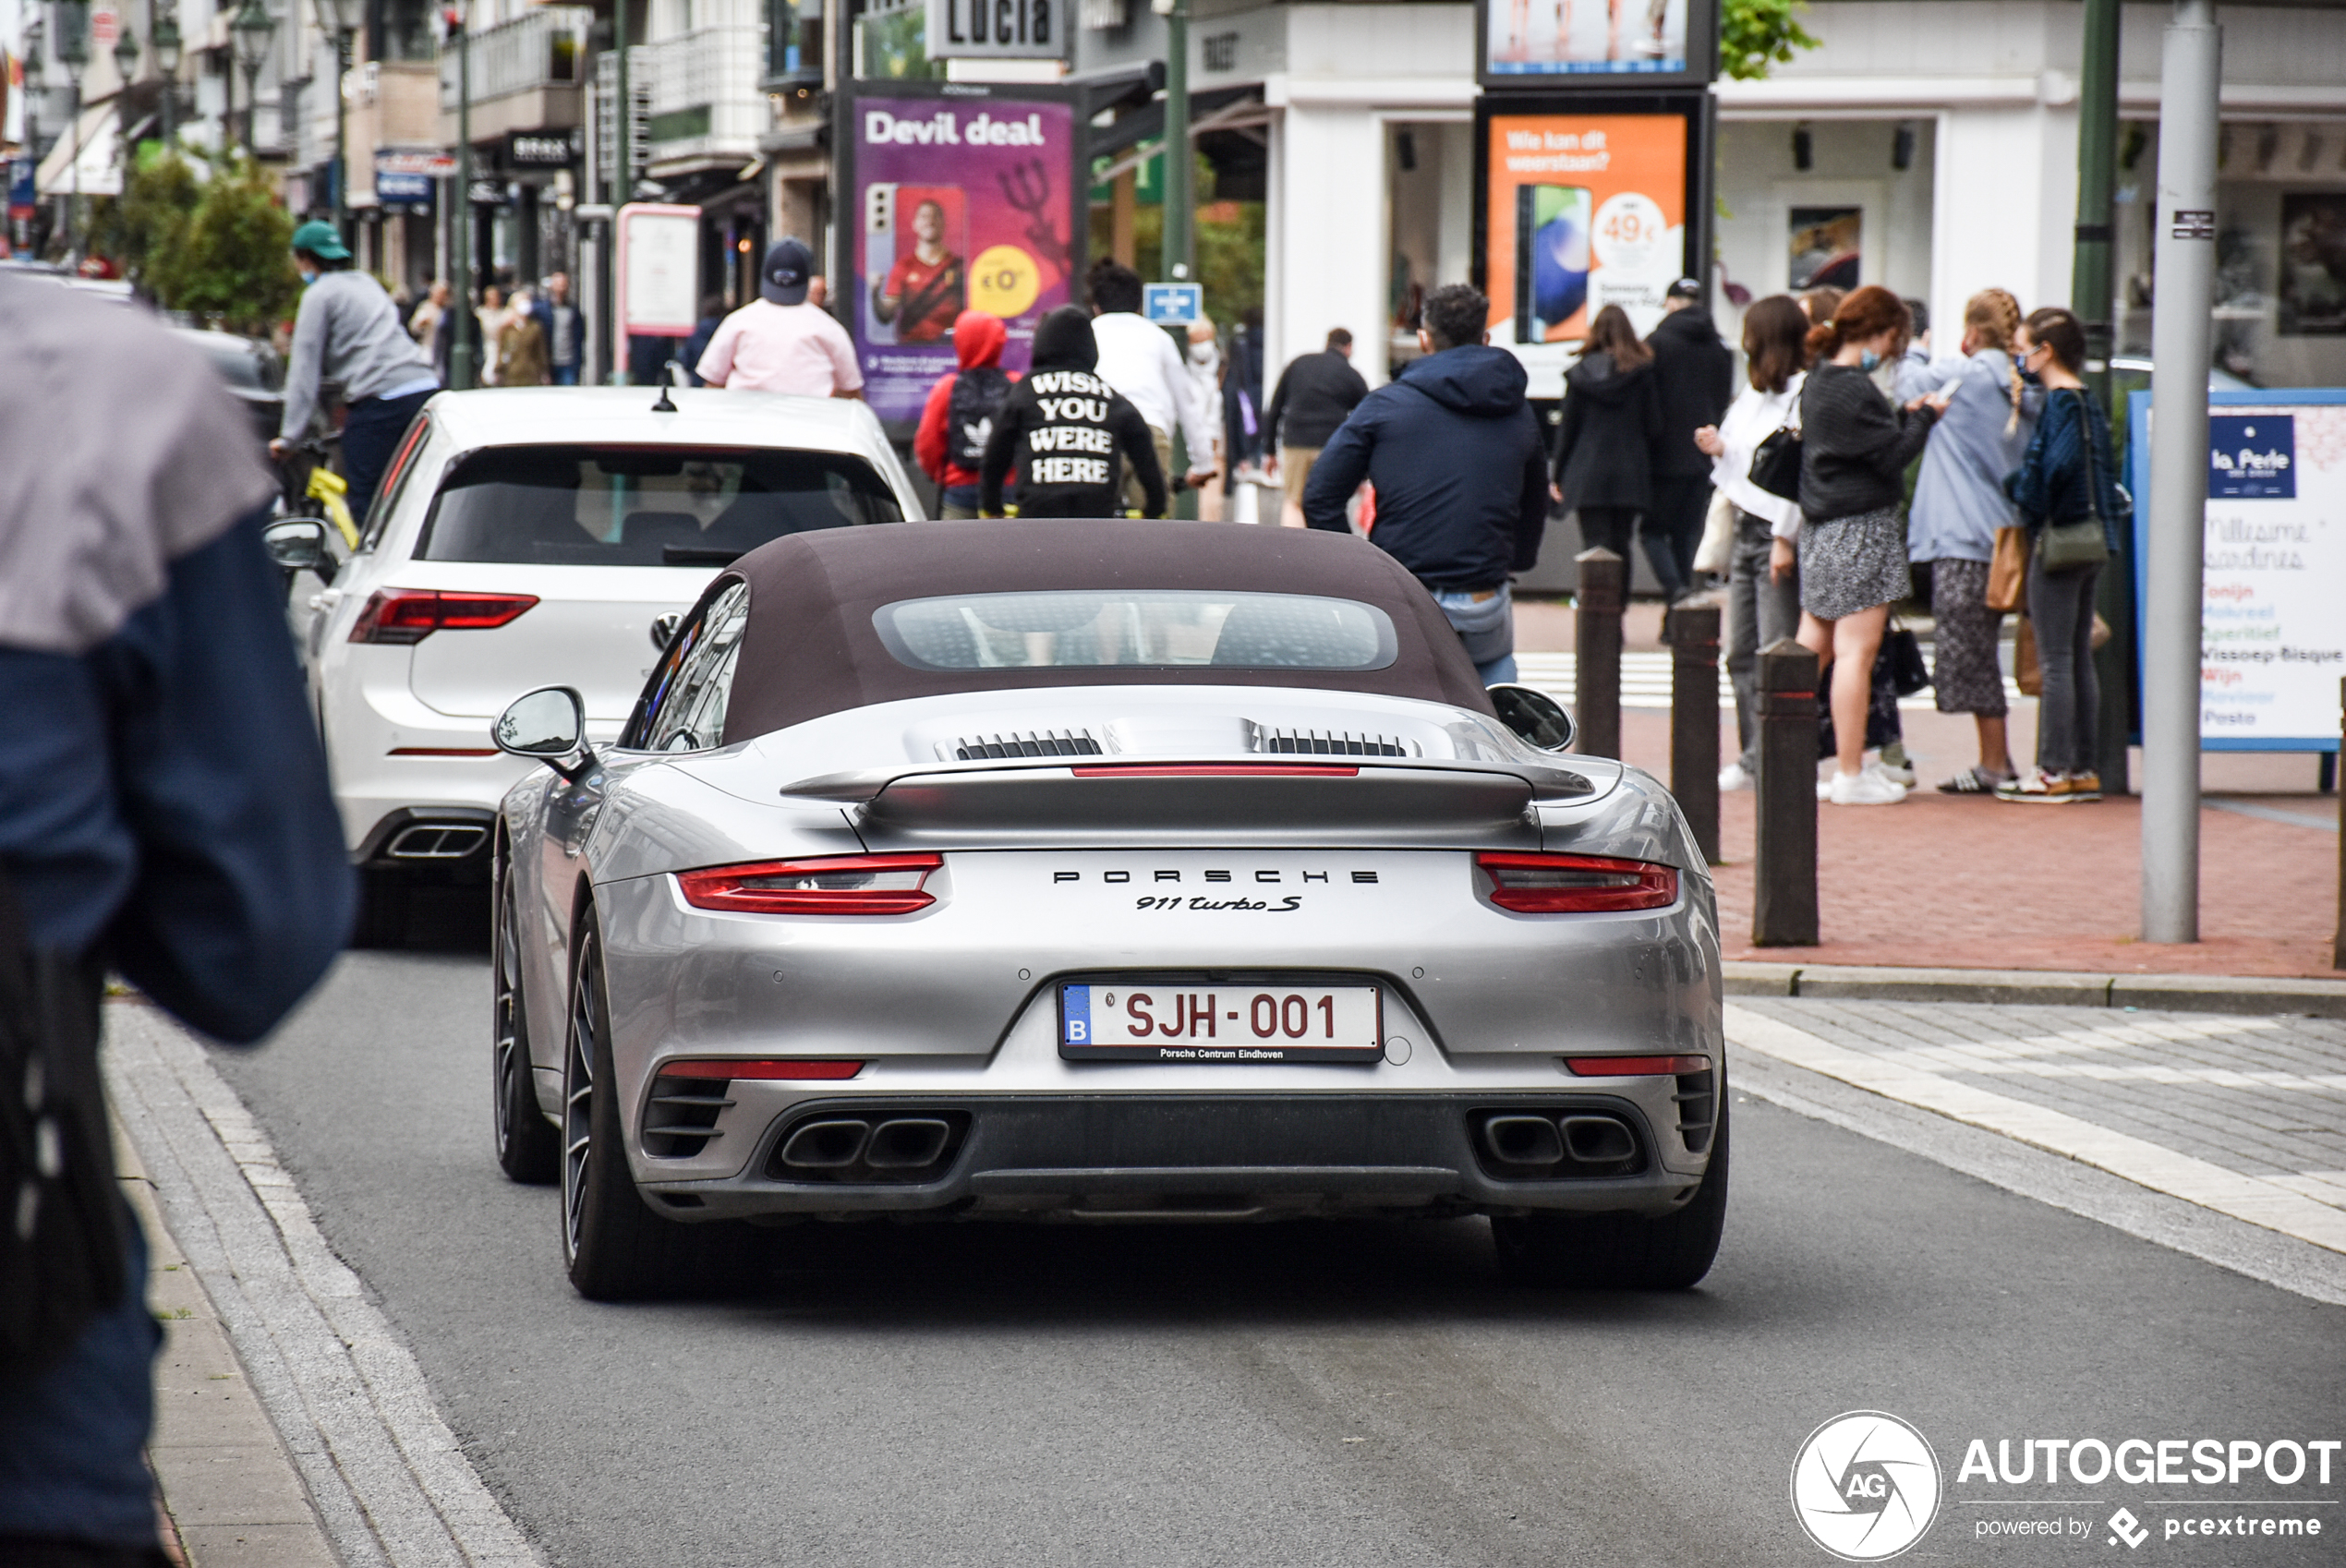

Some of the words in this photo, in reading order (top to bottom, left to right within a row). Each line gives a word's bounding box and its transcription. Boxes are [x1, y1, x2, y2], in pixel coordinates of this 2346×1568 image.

[865, 110, 961, 145] Devil
[965, 112, 1046, 146] deal
[1506, 131, 1542, 150] Wie
[1544, 130, 1579, 150] kan
[1581, 130, 1607, 150] dit
[1506, 151, 1611, 172] weerstaan?
[1605, 214, 1640, 242] 49
[1031, 370, 1113, 400] WISH
[1036, 397, 1108, 423] YOU
[1029, 426, 1113, 454] WERE
[2211, 449, 2234, 469] la
[2239, 448, 2290, 469] Perle
[1031, 456, 1110, 485] HERE
[2201, 668, 2243, 687] Wijn
[1053, 870, 1379, 884] PORSCHE
[1136, 896, 1182, 911] 911
[1189, 897, 1267, 911] turbo
[1267, 896, 1302, 911] S
[1069, 1019, 1087, 1041] B
[1126, 992, 1334, 1038] SJH-001
[1160, 1048, 1196, 1058] Porsche
[1198, 1048, 1236, 1058] Centrum
[1238, 1049, 1284, 1059] Eindhoven
